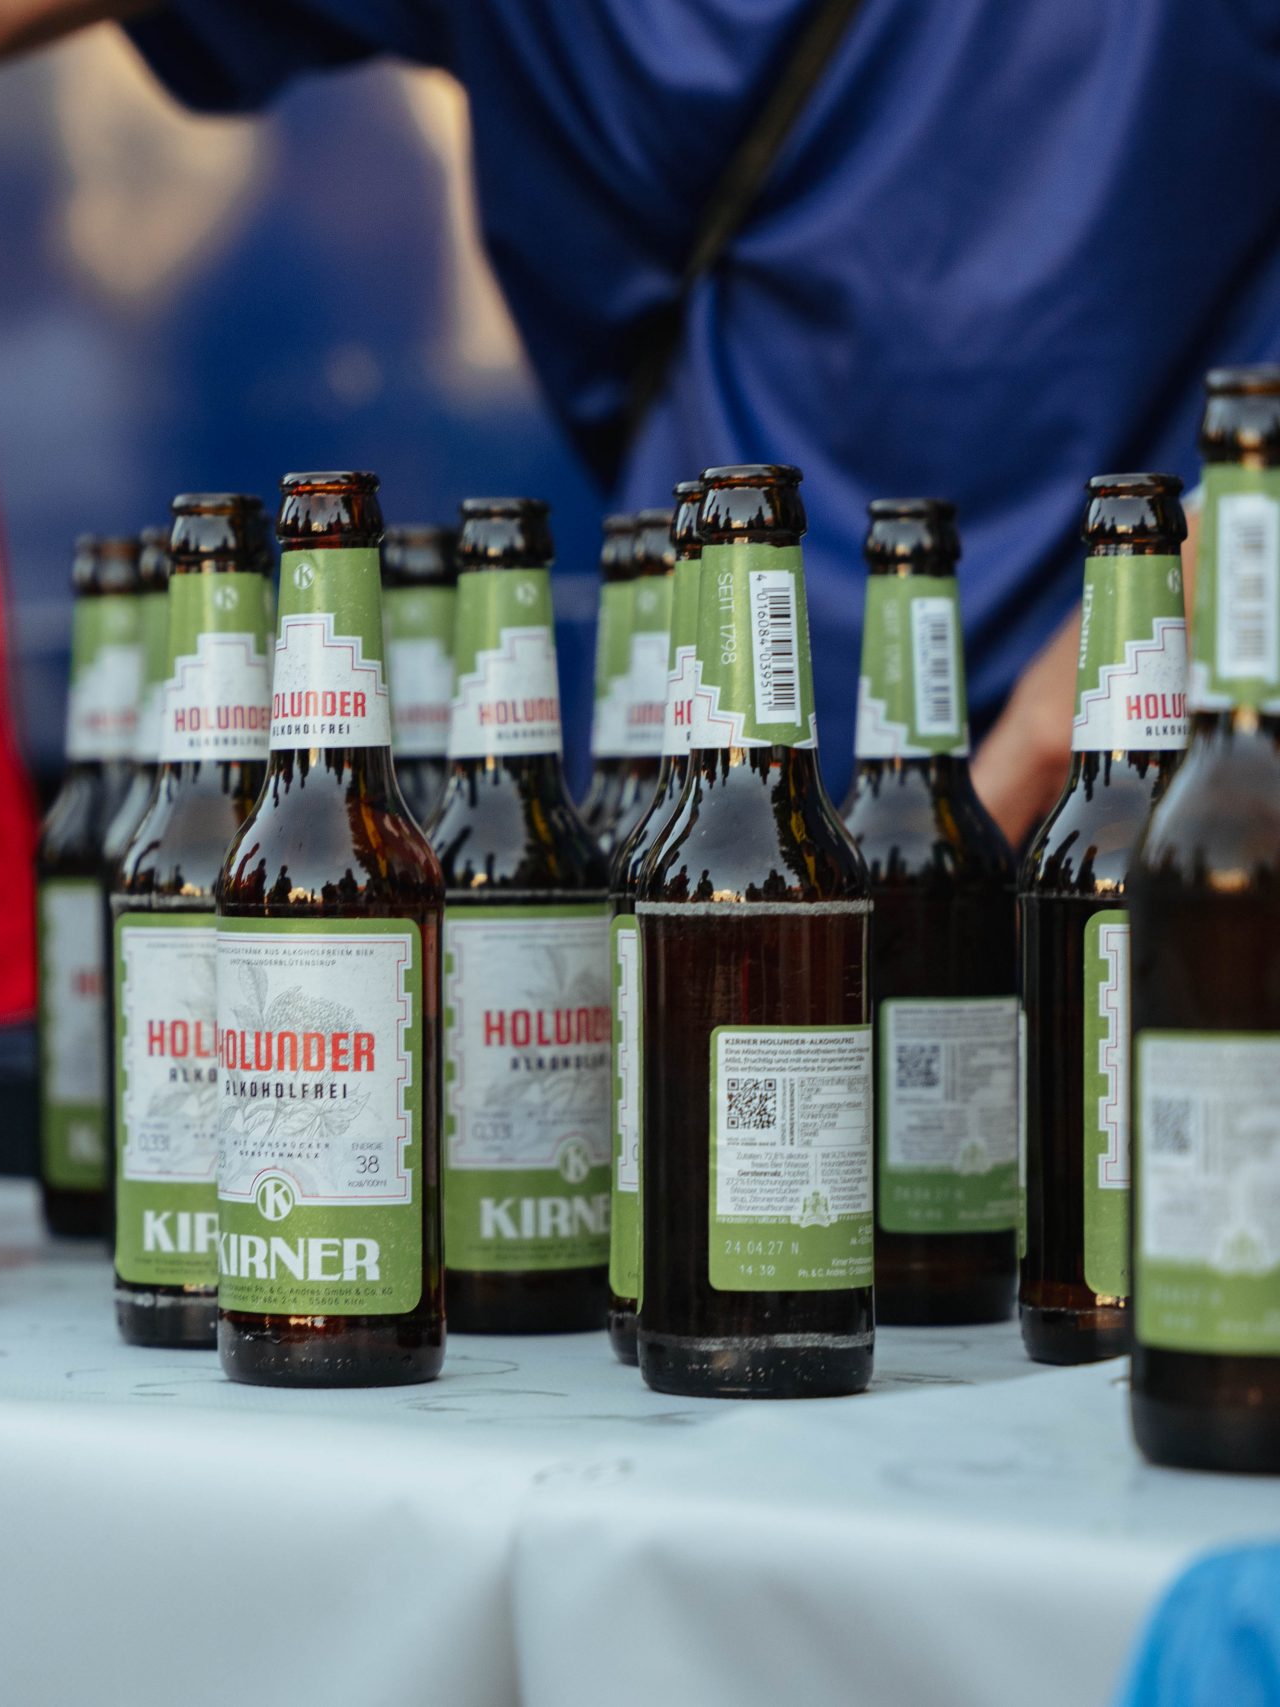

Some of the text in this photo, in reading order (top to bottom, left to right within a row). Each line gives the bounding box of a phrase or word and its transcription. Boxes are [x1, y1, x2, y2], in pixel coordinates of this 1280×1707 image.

[718, 572, 737, 665] SEIT 1798
[757, 592, 770, 645] 016084
[759, 652, 773, 706] 039511
[220, 1029, 375, 1073] HOLUNDER
[725, 1037, 757, 1046] KIRNER
[225, 1079, 348, 1099] ALKOHOLFREI
[355, 1154, 380, 1175] 38
[260, 1177, 291, 1220] K
[219, 1233, 381, 1282] KIRNER
